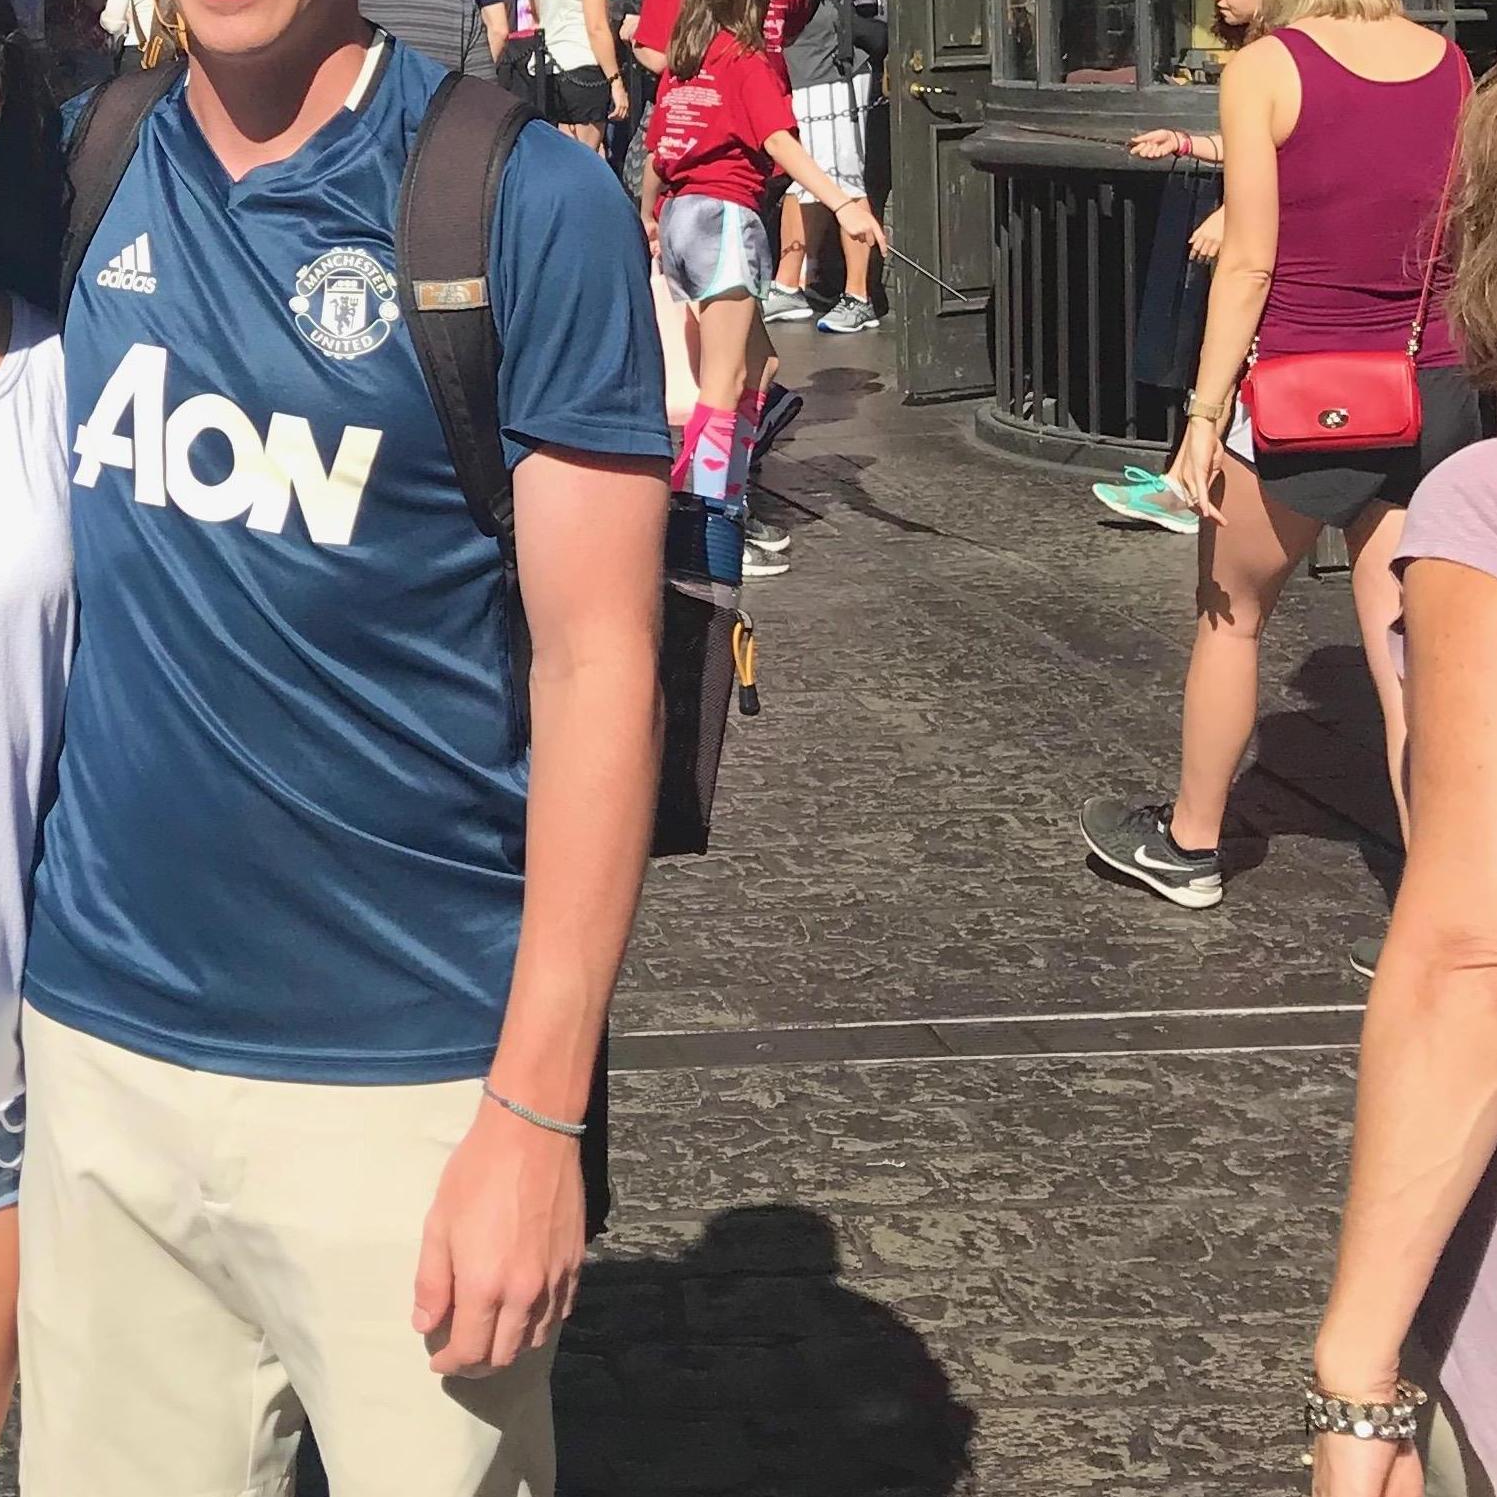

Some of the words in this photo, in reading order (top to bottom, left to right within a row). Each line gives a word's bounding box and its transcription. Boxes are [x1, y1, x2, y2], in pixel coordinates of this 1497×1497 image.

[96, 266, 158, 295] adidas
[303, 255, 389, 295] MANCHESTER
[310, 329, 374, 352] UNITED
[72, 342, 384, 546] AON
